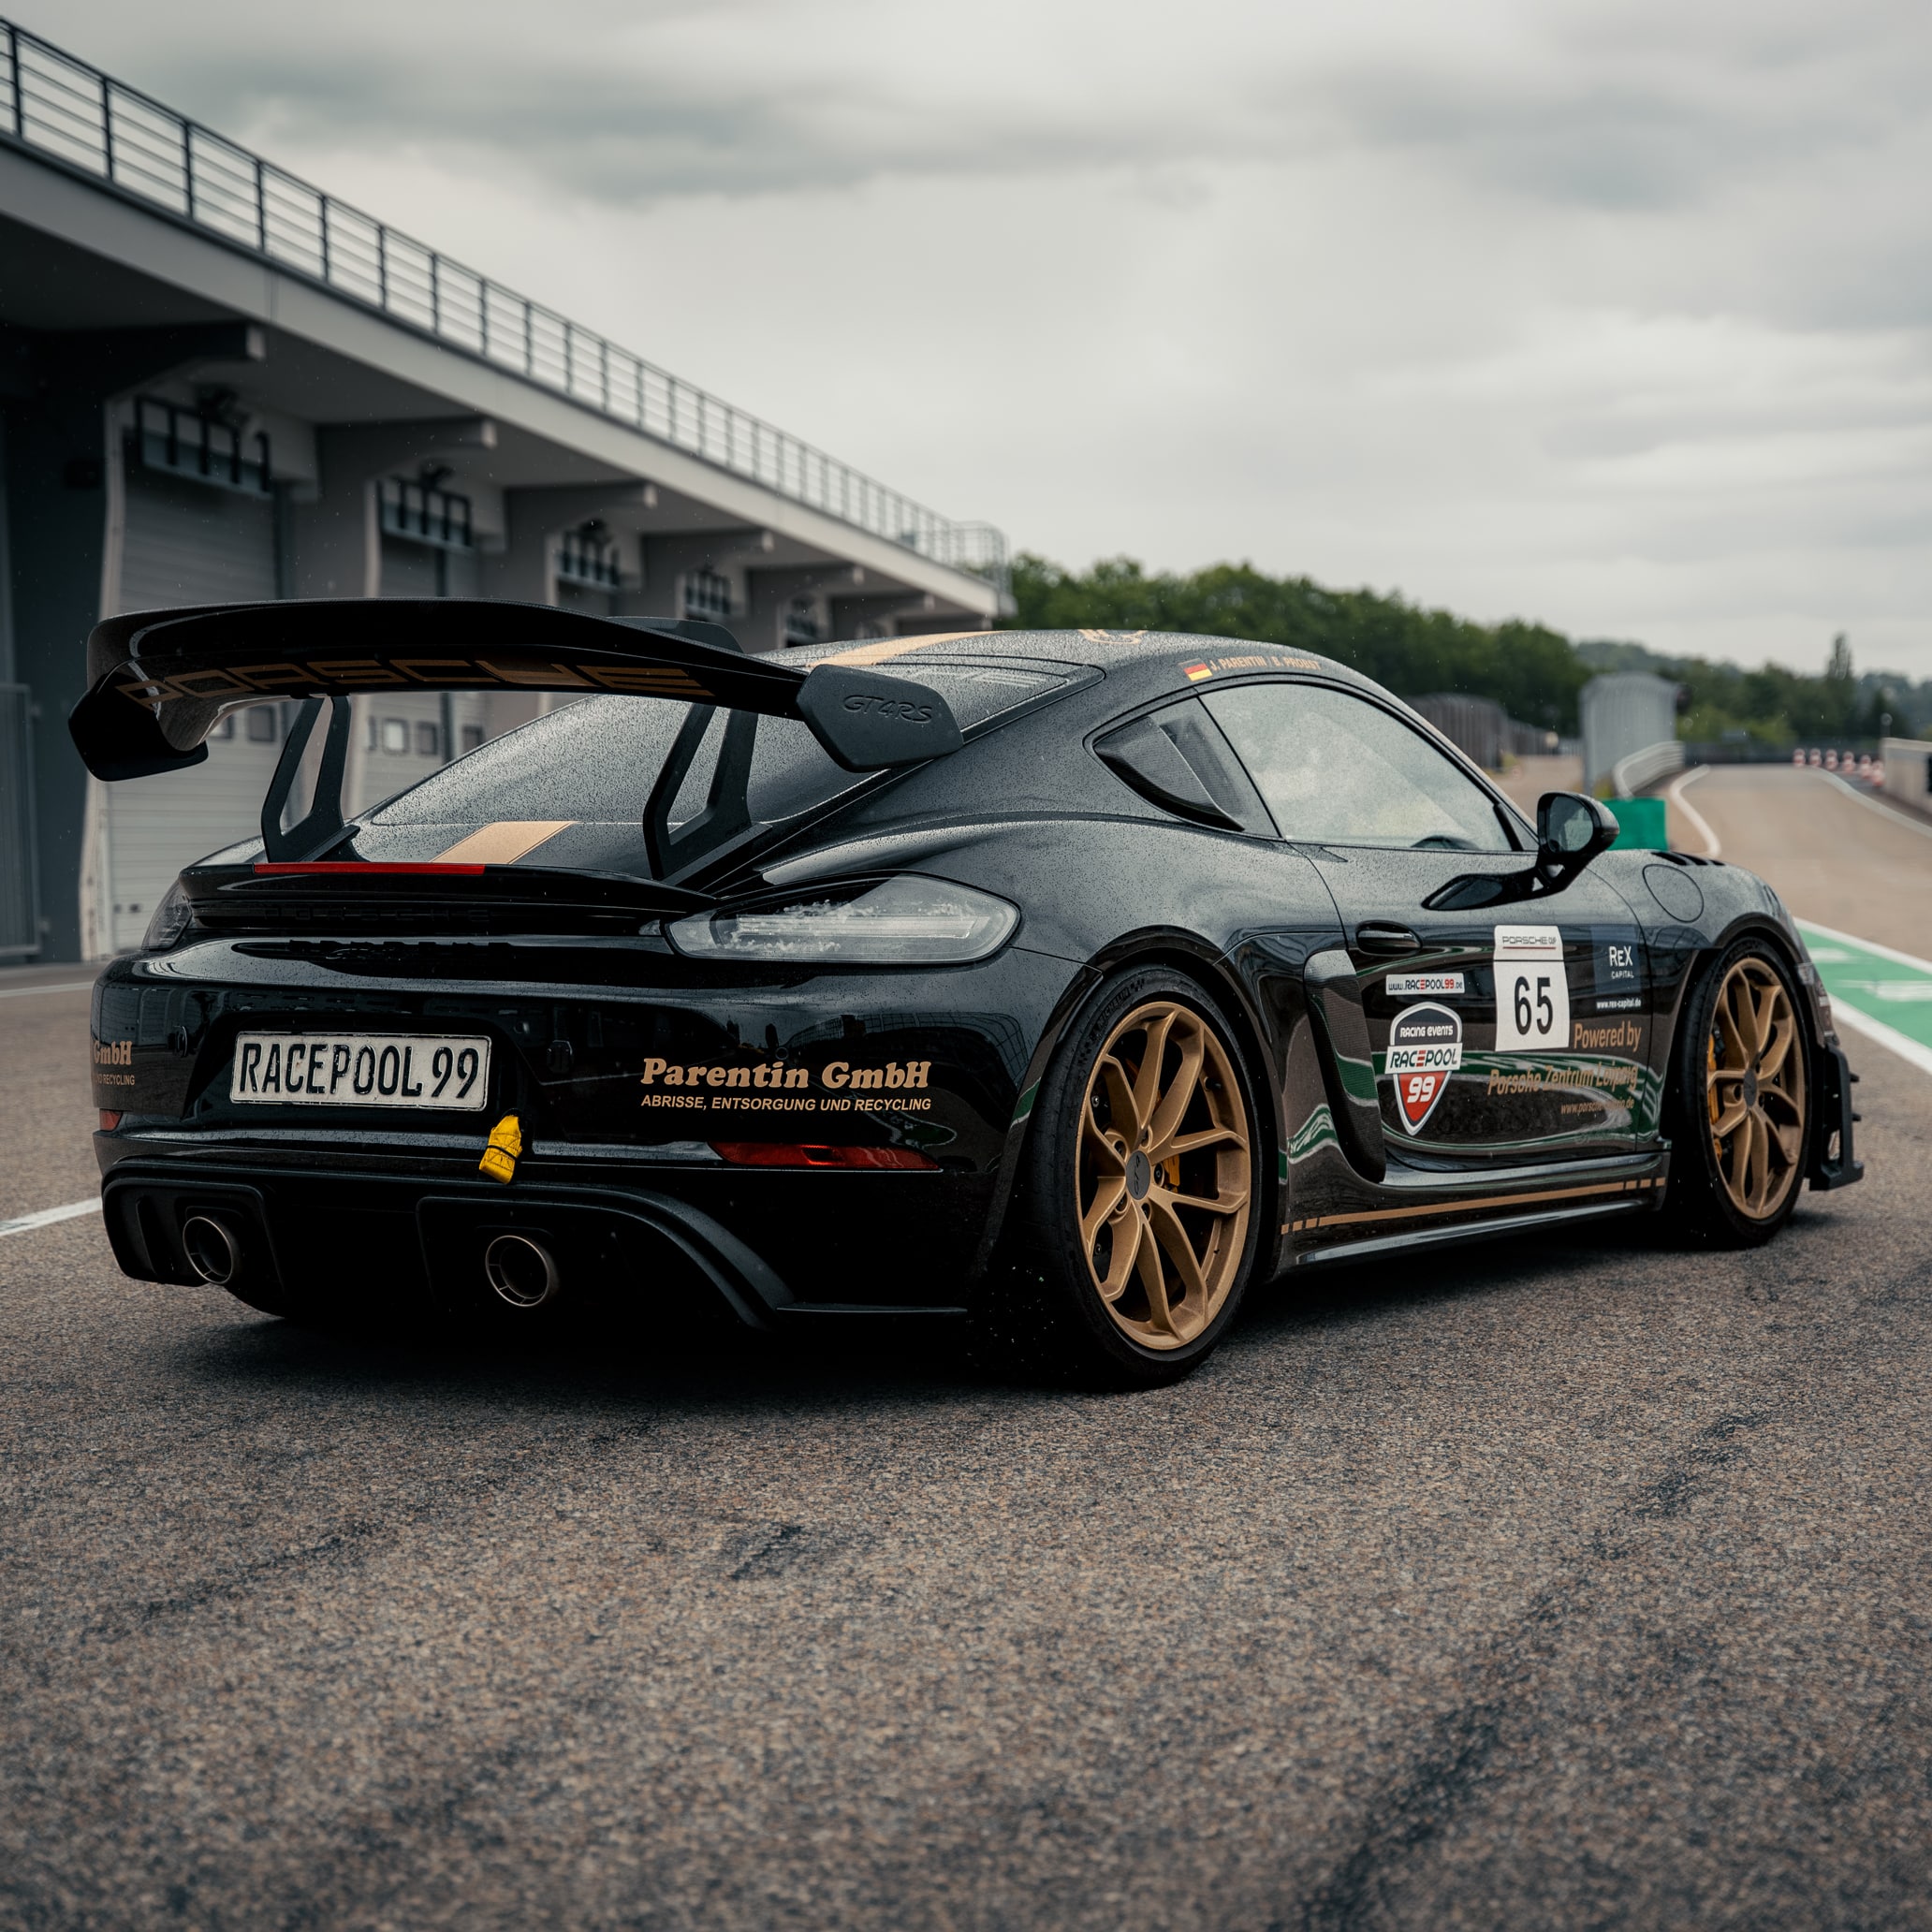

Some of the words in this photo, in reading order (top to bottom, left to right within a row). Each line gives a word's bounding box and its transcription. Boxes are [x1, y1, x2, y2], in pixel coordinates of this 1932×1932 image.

[1219, 655, 1267, 670] PARENTIN
[1282, 656, 1321, 671] PROBST
[1501, 936, 1547, 944] PORSCHE
[1611, 970, 1634, 979] CAPITAL
[1515, 975, 1553, 1035] 65
[1573, 1020, 1625, 1049] Powered
[1626, 1020, 1642, 1052] by
[94, 1040, 133, 1065] GmbH
[1390, 1047, 1457, 1069] RACEPOOL
[103, 1074, 136, 1086] RECYCLING
[240, 1043, 422, 1097] RACEPOOL
[432, 1046, 479, 1099] 99
[640, 1058, 810, 1089] Parentin
[821, 1061, 931, 1089] GmbH
[1487, 1069, 1542, 1095] Porsche
[1543, 1065, 1595, 1091] Zentrum
[1407, 1076, 1436, 1103] 99
[641, 1094, 707, 1111] ABRISSE,
[711, 1097, 816, 1111] ENTSORGUNG
[820, 1098, 851, 1111] UND
[854, 1098, 931, 1111] RECYCLING
